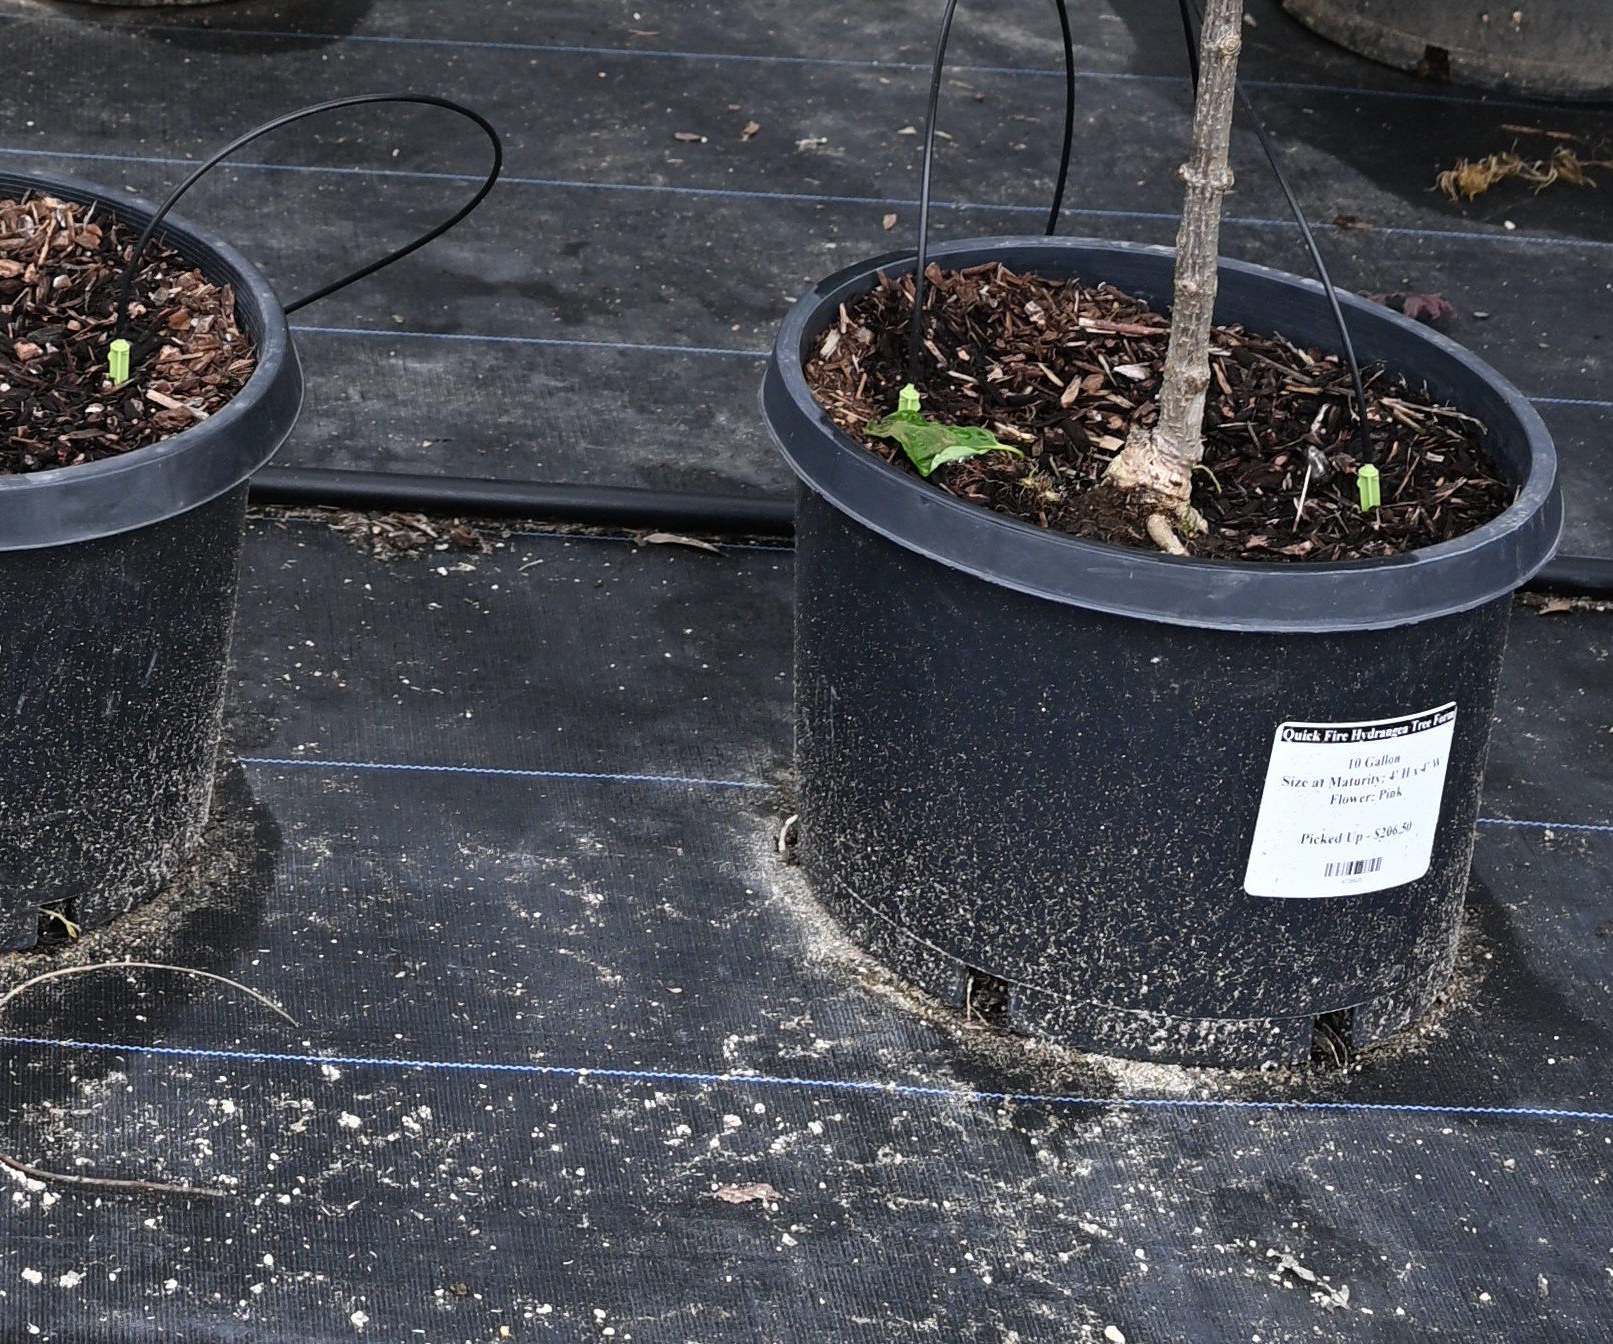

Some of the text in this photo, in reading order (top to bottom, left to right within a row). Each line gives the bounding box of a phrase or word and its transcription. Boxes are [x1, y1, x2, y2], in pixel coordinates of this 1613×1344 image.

[1282, 709, 1456, 743] Quick Fire Hydrangea Tree Form
[1348, 753, 1401, 769] 10 Gallon
[1281, 776, 1309, 788] Size
[1311, 778, 1325, 788] at
[1328, 774, 1385, 790] Maturity:
[1330, 787, 1402, 806] Flower: Pink
[1300, 832, 1342, 845] Picked
[1346, 831, 1363, 845] Up
